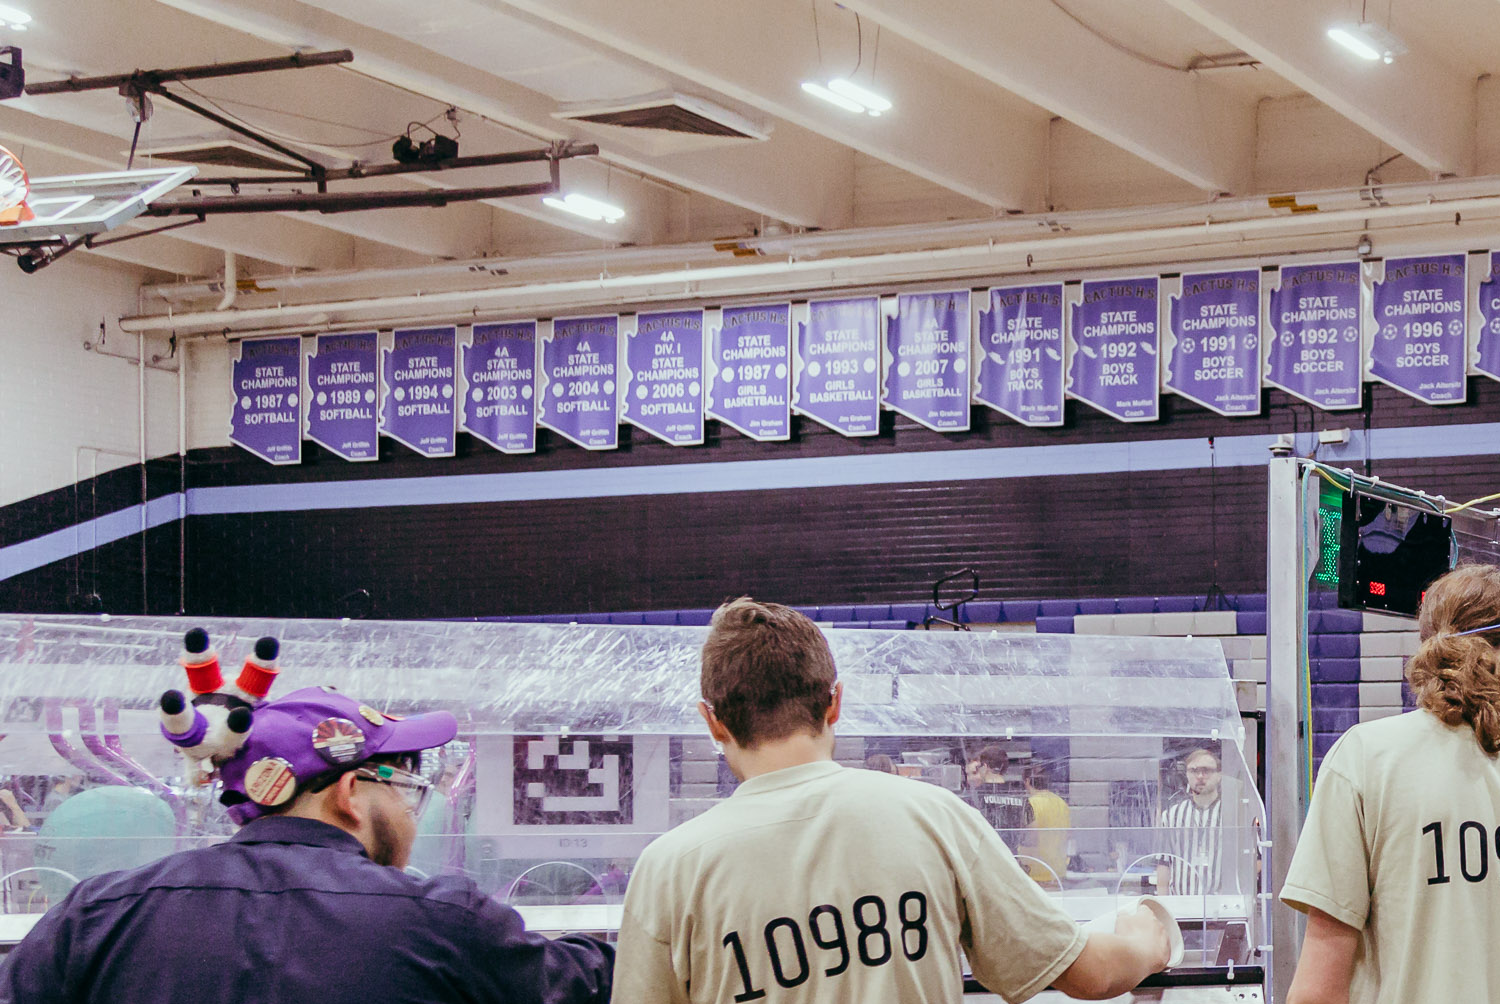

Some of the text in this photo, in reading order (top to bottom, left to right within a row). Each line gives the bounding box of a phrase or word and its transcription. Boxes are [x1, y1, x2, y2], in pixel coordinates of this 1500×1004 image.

[1386, 263, 1438, 282] CACTUS
[1184, 279, 1233, 297] CACTUS
[1403, 289, 1443, 302] STATE
[1299, 296, 1338, 309] STATE
[1385, 301, 1461, 317] CHAMPIONS
[1200, 303, 1238, 317] STATE
[1282, 308, 1356, 323] CHAMPIONS
[1007, 317, 1042, 330] STATE
[1101, 311, 1137, 324] STATE
[1183, 315, 1256, 331] CHAMPIONS
[825, 329, 859, 342] STATE
[914, 330, 948, 342] STATE
[1084, 322, 1154, 337] CHAMPIONS
[1299, 328, 1338, 344] 1992
[1403, 322, 1443, 338] 1996
[660, 331, 675, 342] 4A
[738, 335, 771, 347] STATE
[991, 329, 1059, 344] CHAMPIONS
[576, 341, 591, 352] 4A
[655, 344, 674, 355] DIV.
[809, 340, 875, 355] CHAMPIONS
[898, 342, 965, 356] CHAMPIONS
[1101, 342, 1136, 358] 1992
[1200, 335, 1236, 352] 1991
[1405, 343, 1440, 355] BOYS
[495, 347, 509, 357] 4A
[723, 346, 785, 361] CHAMPIONS
[1009, 348, 1040, 364] 1991
[1301, 349, 1335, 361] BOYS
[408, 357, 438, 369] STATE
[487, 358, 517, 370] STATE
[568, 353, 599, 365] STATE
[652, 357, 684, 369] STATE
[1202, 356, 1234, 368] BOYS
[1396, 355, 1449, 368] SOCCER
[255, 366, 284, 377] STATE
[330, 362, 360, 373] STATE
[553, 364, 614, 377] CHAMPIONS
[738, 365, 771, 381] 1987
[825, 360, 858, 375] 1993
[915, 359, 948, 375] 2007
[1102, 363, 1134, 375] BOYS
[1294, 361, 1344, 374] SOCCER
[317, 372, 374, 386] CHAMPIONS
[394, 367, 452, 381] CHAMPIONS
[473, 369, 531, 383] CHAMPIONS
[637, 368, 699, 382] CHAMPIONS
[1010, 368, 1039, 380] BOYS
[1099, 374, 1138, 386] TRACK
[1194, 367, 1243, 381] SOCCER
[242, 377, 297, 389] CHAMPIONS
[568, 380, 599, 396] 2004
[825, 379, 854, 391] GIRLS
[917, 378, 943, 388] GIRLS
[1008, 379, 1043, 392] TRACK
[408, 385, 438, 400] 1994
[487, 385, 517, 400] 2003
[653, 383, 684, 398] 2006
[738, 385, 766, 396] GIRLS
[810, 390, 873, 403] BASKETBALL
[903, 388, 962, 400] BASKETBALL
[255, 394, 283, 409] 1987
[330, 390, 360, 405] 1989
[724, 395, 785, 409] BASKETBALL
[398, 403, 450, 416] SOFTBALL
[476, 405, 528, 418] SOFTBALL
[557, 400, 610, 413] SOFTBALL
[641, 402, 695, 416] SOFTBALL
[245, 412, 295, 425] SOFTBALL
[320, 408, 372, 421] SOFTBALL
[722, 891, 928, 1004] 10988
